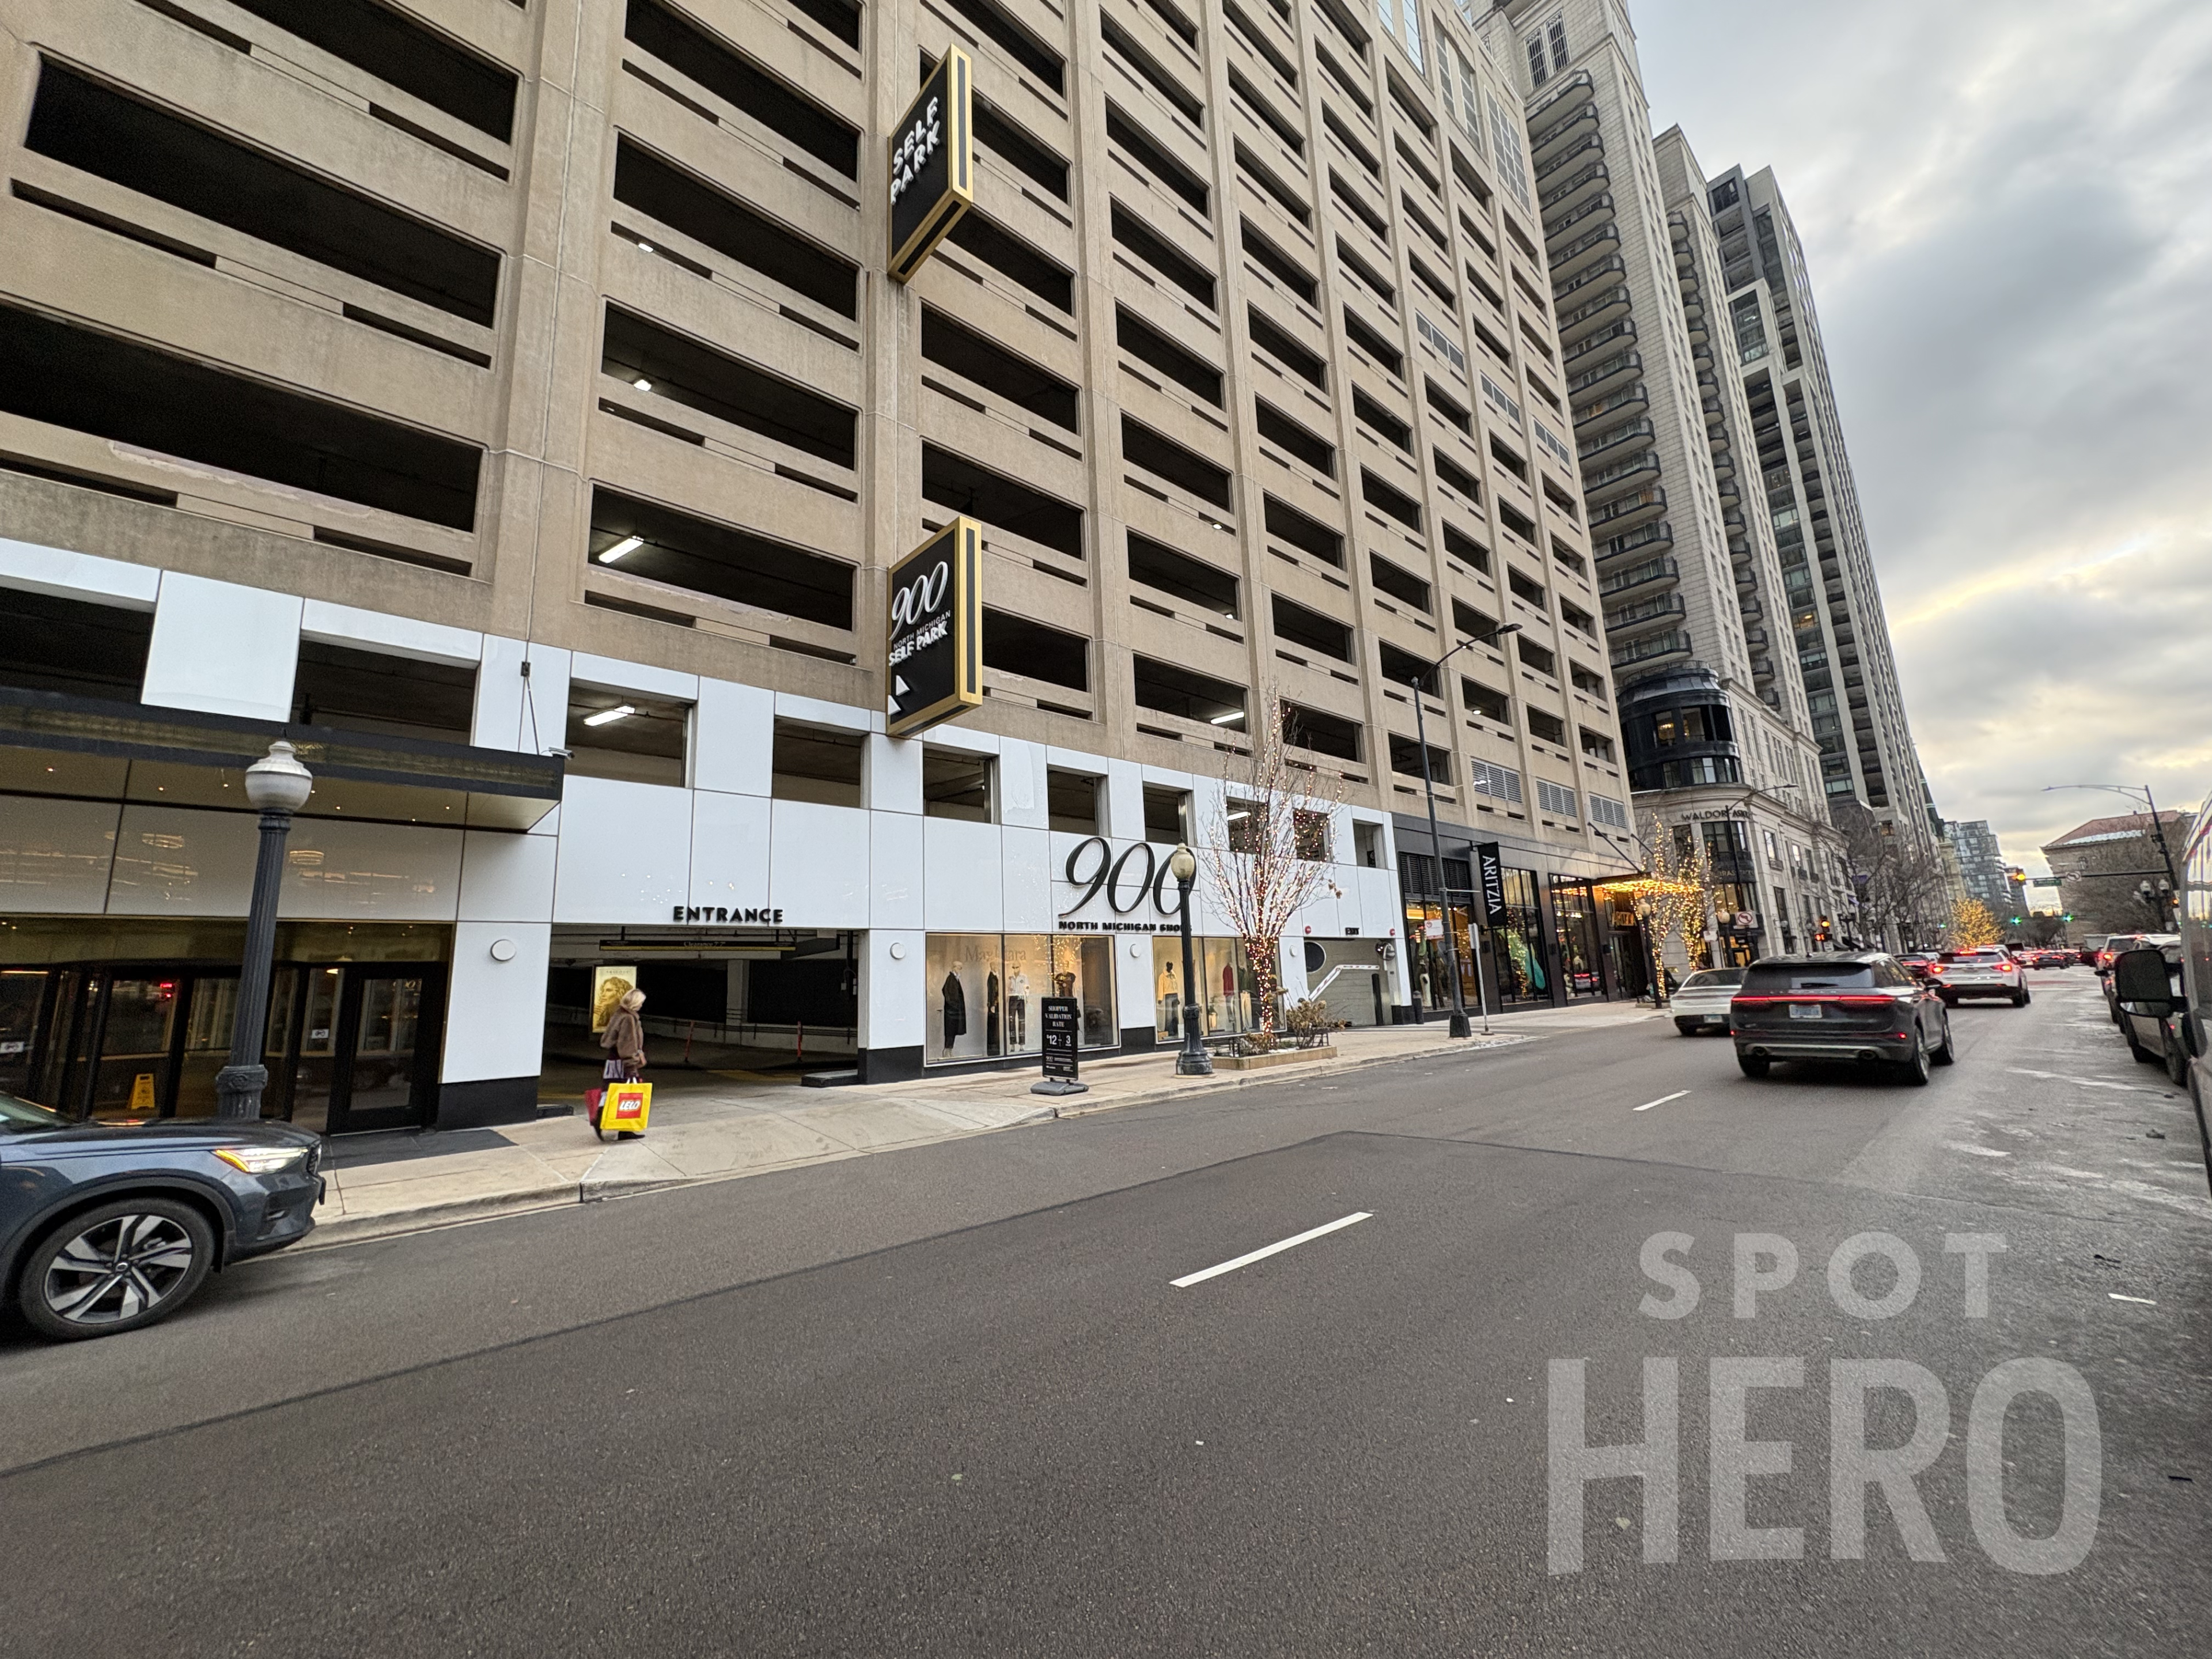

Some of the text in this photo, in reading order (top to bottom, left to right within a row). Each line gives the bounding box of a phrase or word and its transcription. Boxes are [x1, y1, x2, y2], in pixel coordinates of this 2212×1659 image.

[891, 120, 940, 205] PARK
[893, 97, 938, 175] SELF
[889, 561, 948, 641] 900
[893, 610, 950, 650] NORTH MICHIGAN
[889, 621, 948, 666] SELF PARK
[1058, 837, 1196, 917] 900
[1482, 855, 1502, 915] ARITZIA
[673, 906, 783, 923] ENTRANCE
[1059, 921, 1098, 930] NORTH
[1103, 923, 1157, 931] MICHIGAN
